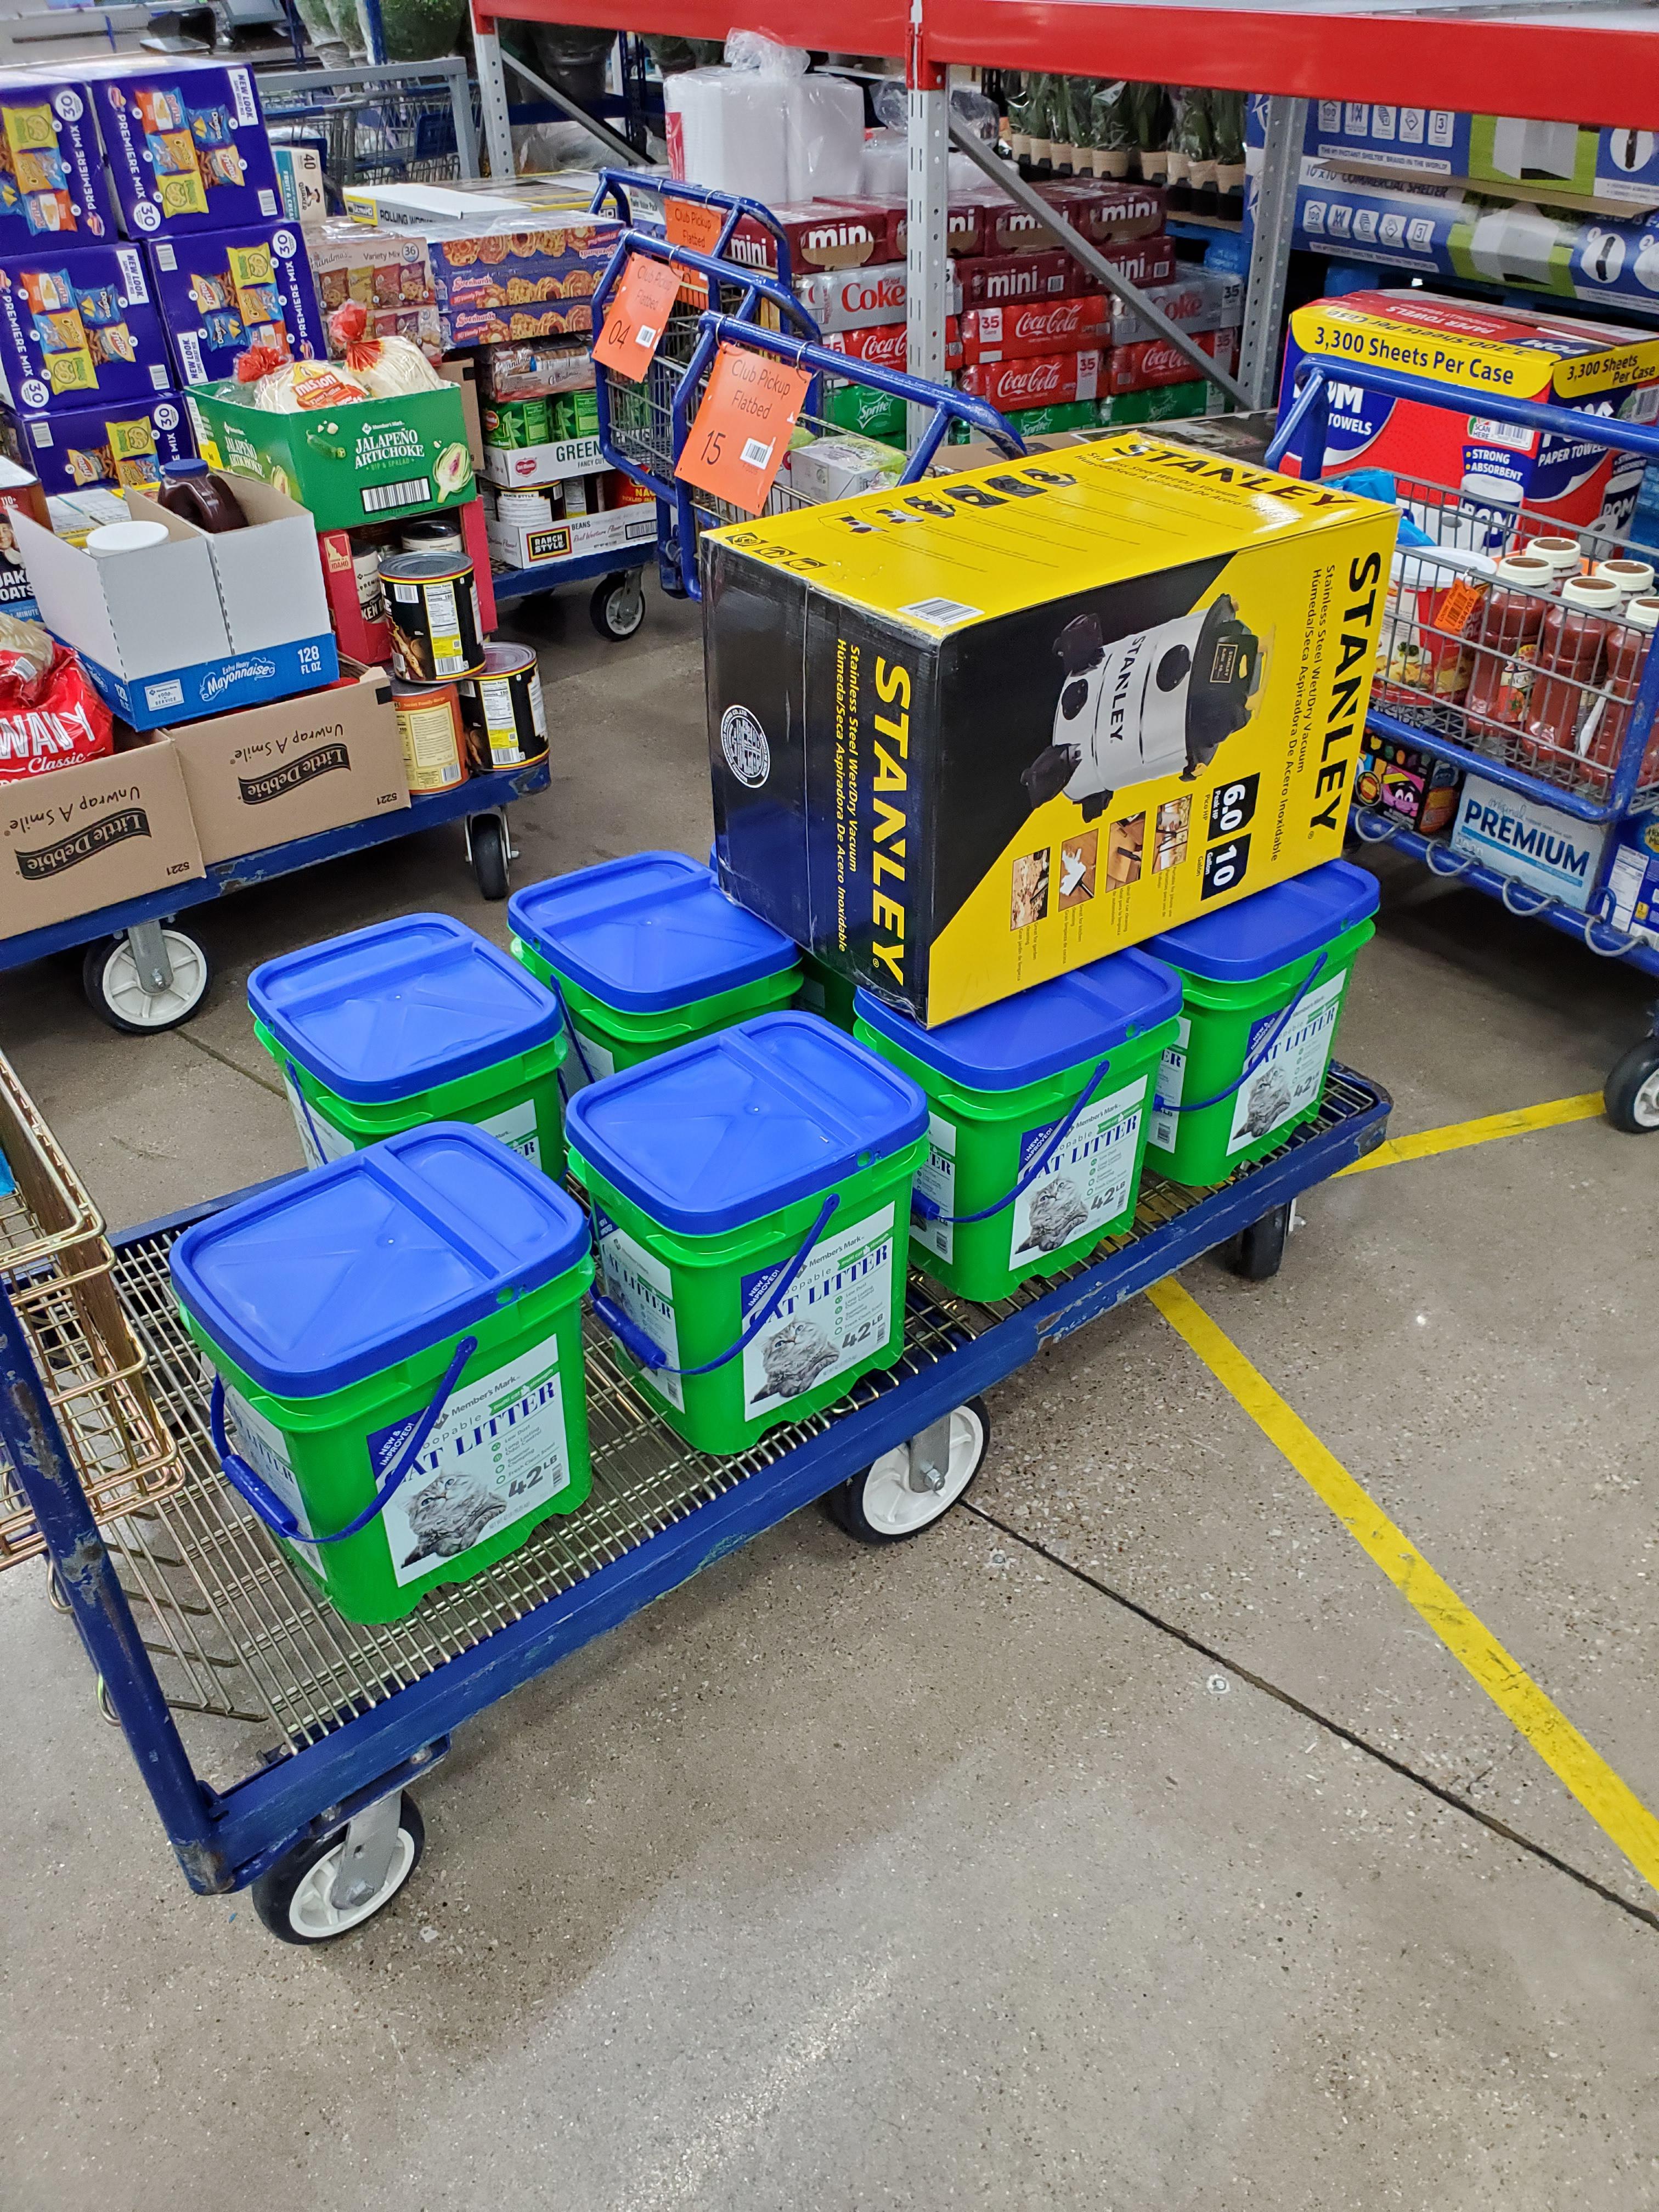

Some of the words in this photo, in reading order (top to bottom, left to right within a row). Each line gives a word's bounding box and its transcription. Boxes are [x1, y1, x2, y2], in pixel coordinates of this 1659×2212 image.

[238, 75, 249, 96] NEW
[61, 95, 75, 117] 30
[70, 125, 83, 148] MIX
[117, 114, 139, 175] PREMIERE
[133, 176, 145, 199] MIX
[303, 154, 315, 170] 40
[76, 151, 97, 210] PREMIERE
[1407, 182, 1448, 198] SHELTER
[141, 205, 156, 227] 30
[380, 211, 408, 225] ROLLING
[675, 208, 690, 223] Club
[691, 213, 711, 233] Pickup
[1101, 197, 1158, 222] mini
[278, 234, 289, 255] 30
[364, 251, 387, 261] Variety
[405, 247, 416, 256] 36
[731, 235, 767, 266] mini
[127, 255, 138, 277] NEW
[285, 261, 296, 282] MIX
[637, 266, 654, 282] Club
[988, 266, 1038, 298] mini
[1224, 284, 1239, 298] 35
[842, 280, 905, 312] Coke
[290, 284, 308, 337] PREMIERE
[982, 315, 999, 328] 35
[1015, 304, 1083, 338] Coca-Cola
[1386, 306, 1450, 325] TOWELS
[2, 295, 26, 353] PREMIERE
[20, 356, 33, 377] MIX
[608, 320, 630, 348] 04
[1369, 319, 1400, 331] Per
[1402, 327, 1464, 345] Sheets
[1451, 319, 1494, 335] PAPER
[1314, 327, 1364, 354] 3,300
[1369, 337, 1427, 366] Sheets
[1434, 351, 1464, 375] Per
[1469, 358, 1514, 385] Case
[1468, 341, 1532, 357] 3,300
[1520, 338, 1590, 356] POM
[189, 359, 199, 379] NEW
[1080, 358, 1096, 371] 35
[1567, 360, 1600, 381] 3,300
[1602, 355, 1638, 373] Sheets
[1613, 371, 1629, 385] Per
[1632, 366, 1656, 380] Case
[731, 359, 755, 382] Club
[758, 369, 791, 400] Pickup
[997, 362, 1063, 399] Coca-Cola
[29, 383, 44, 403] 30
[732, 390, 773, 419] Flatbed
[159, 408, 171, 427] 30
[861, 398, 889, 419] Sprite
[1023, 420, 1051, 436] Sprite
[1328, 413, 1373, 436] TOWELS
[1474, 431, 1489, 439] HERE
[1475, 424, 1491, 432] SCAN
[167, 433, 178, 453] MIX
[356, 428, 418, 454] JALAPEÑO
[556, 440, 602, 462] GREEN
[701, 430, 726, 465] 15
[355, 444, 425, 470] ARTICHOKE
[578, 459, 594, 469] FANCY
[1472, 449, 1510, 464] STRONG
[1538, 448, 1568, 467] PAPER
[1571, 443, 1607, 459] TOWELS
[1113, 444, 1361, 507] STANLEY
[1471, 462, 1523, 481] ABSORBENT
[1200, 483, 1240, 499] Vacuum
[1603, 495, 1635, 516] POM
[572, 521, 591, 531] BEANS
[535, 534, 563, 546] RANCH
[535, 541, 565, 554] STYLE
[331, 560, 348, 569] IDAHO
[1319, 565, 1335, 625] Stainless
[1302, 568, 1322, 662] Húmeda/Seca
[297, 645, 319, 664] 128
[1313, 627, 1327, 668] Steel
[222, 664, 235, 675] Extra
[236, 660, 249, 672] Heavy
[301, 664, 311, 675] FL
[312, 661, 321, 673] OZ
[850, 644, 861, 713] Stainless
[207, 663, 270, 696] Mayonnaise
[836, 639, 847, 740] Húmeda/Seca
[1110, 635, 1146, 742] STANLEY
[1310, 551, 1381, 830] STANLEY
[155, 696, 177, 706] SERVICE
[1290, 666, 1308, 737] Aspiradora
[1304, 669, 1321, 720] Wet/Dry
[0, 701, 96, 759] WAVY
[292, 723, 344, 744] Unwrap
[850, 715, 859, 755] Steel
[234, 741, 272, 764] Smile
[276, 737, 288, 754] A
[1288, 738, 1297, 756] De
[1296, 721, 1311, 774] Vacuum
[28, 751, 87, 774] Classic
[302, 749, 343, 775] Little
[247, 769, 301, 800] Debbie
[836, 742, 846, 821] Aspiradora
[849, 757, 859, 816] Wet/Dry
[1280, 760, 1294, 797] Acero
[80, 786, 141, 811] Unwrap
[376, 792, 397, 805] 5221
[1213, 790, 1221, 809] Peak
[1220, 784, 1245, 831] 6.0
[9, 809, 54, 833] Smile
[59, 803, 74, 822] A
[873, 656, 911, 986] STANLEY
[1203, 810, 1208, 821] HP
[1212, 809, 1219, 820] HP
[92, 813, 144, 843] Little
[837, 823, 845, 838] De
[1270, 798, 1289, 862] Inoxidable
[1464, 799, 1590, 877] PREMIUM
[26, 834, 92, 870] Debbie
[849, 817, 857, 872] Vacuum
[166, 862, 190, 876] 5221
[837, 839, 845, 883] Acero
[1205, 852, 1214, 875] Gallon
[1213, 844, 1237, 886] 10
[837, 885, 845, 952] Inoxidable
[1285, 1006, 1335, 1053] LITTER
[1294, 1076, 1312, 1098] 42
[1076, 1112, 1104, 1129] Member's
[1104, 1105, 1119, 1115] Mark
[1024, 1127, 1054, 1161] IMPROVED!
[1026, 1137, 1040, 1152] NEW
[1071, 1115, 1137, 1164] LITTER
[1091, 1187, 1115, 1210] 42
[1116, 1181, 1125, 1192] LB
[809, 1246, 843, 1268] Member's
[844, 1236, 862, 1250] Mark
[808, 1244, 888, 1306] LITTER
[747, 1269, 781, 1307] IMPROVED!
[748, 1279, 764, 1297] NEW
[842, 1321, 872, 1349] 42
[872, 1313, 884, 1326] LB
[452, 1388, 493, 1416] Member's
[494, 1375, 516, 1392] Mark
[510, 1391, 522, 1401] cat
[454, 1380, 556, 1457] LITTER
[379, 1422, 415, 1466] IMPROVED!
[379, 1436, 396, 1456] NEW
[504, 1432, 516, 1443] Low
[508, 1465, 544, 1498] 42
[543, 1454, 558, 1470] LB
